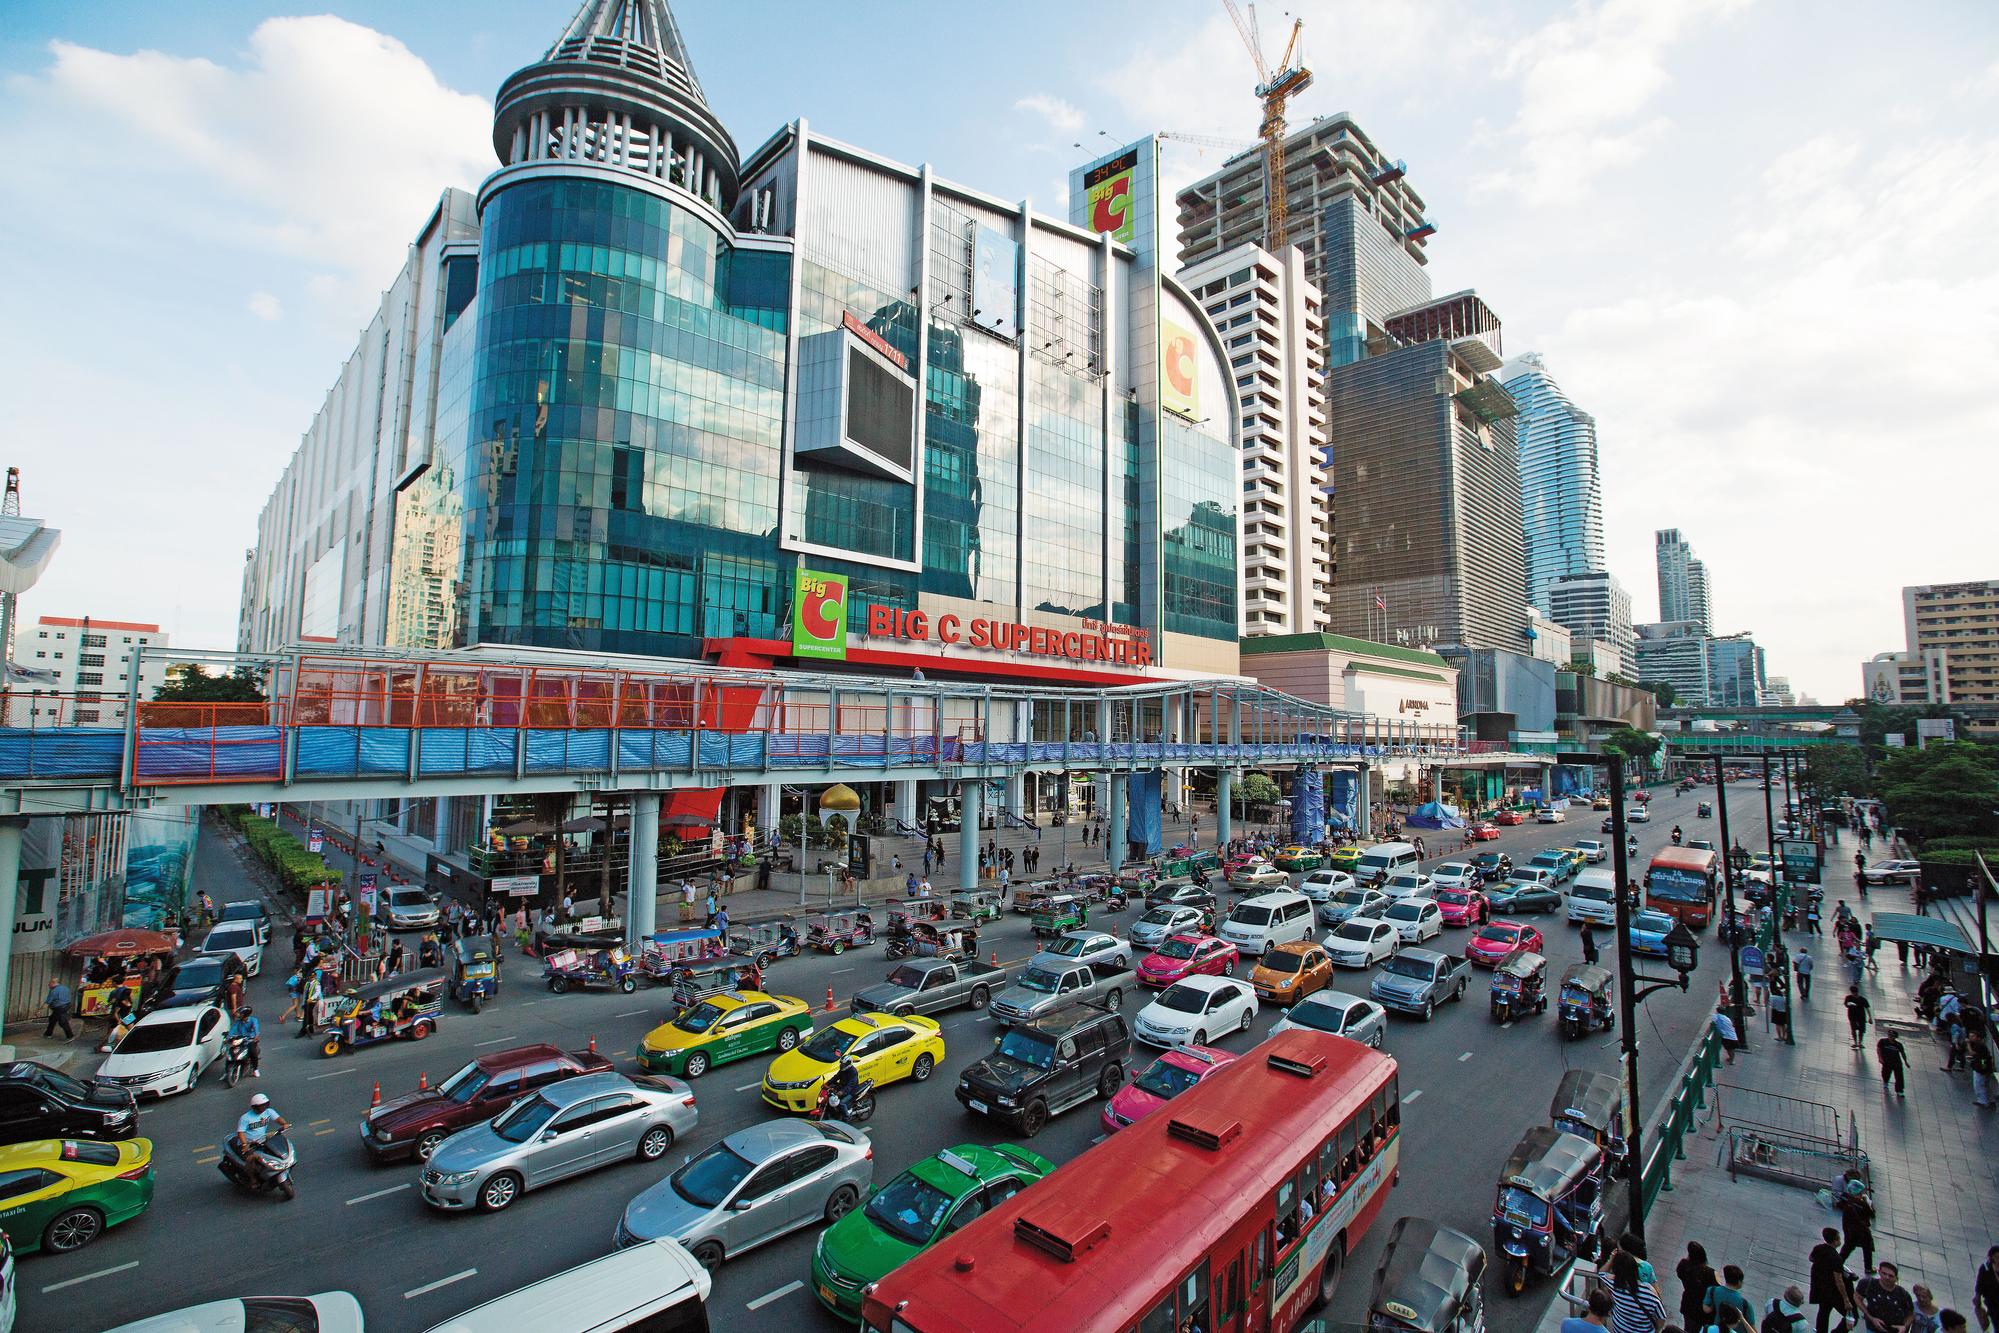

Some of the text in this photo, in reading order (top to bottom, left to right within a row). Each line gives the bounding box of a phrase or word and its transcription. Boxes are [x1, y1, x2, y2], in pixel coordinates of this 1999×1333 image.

[1092, 184, 1114, 202] Big
[801, 576, 827, 598] Big
[801, 581, 845, 640] C
[868, 604, 1151, 665] BIG C SUPERCENTER
[799, 643, 842, 654] SUPERCENTER
[2, 1209, 16, 1218] TAXI
[1392, 1304, 1410, 1316] TAXI
